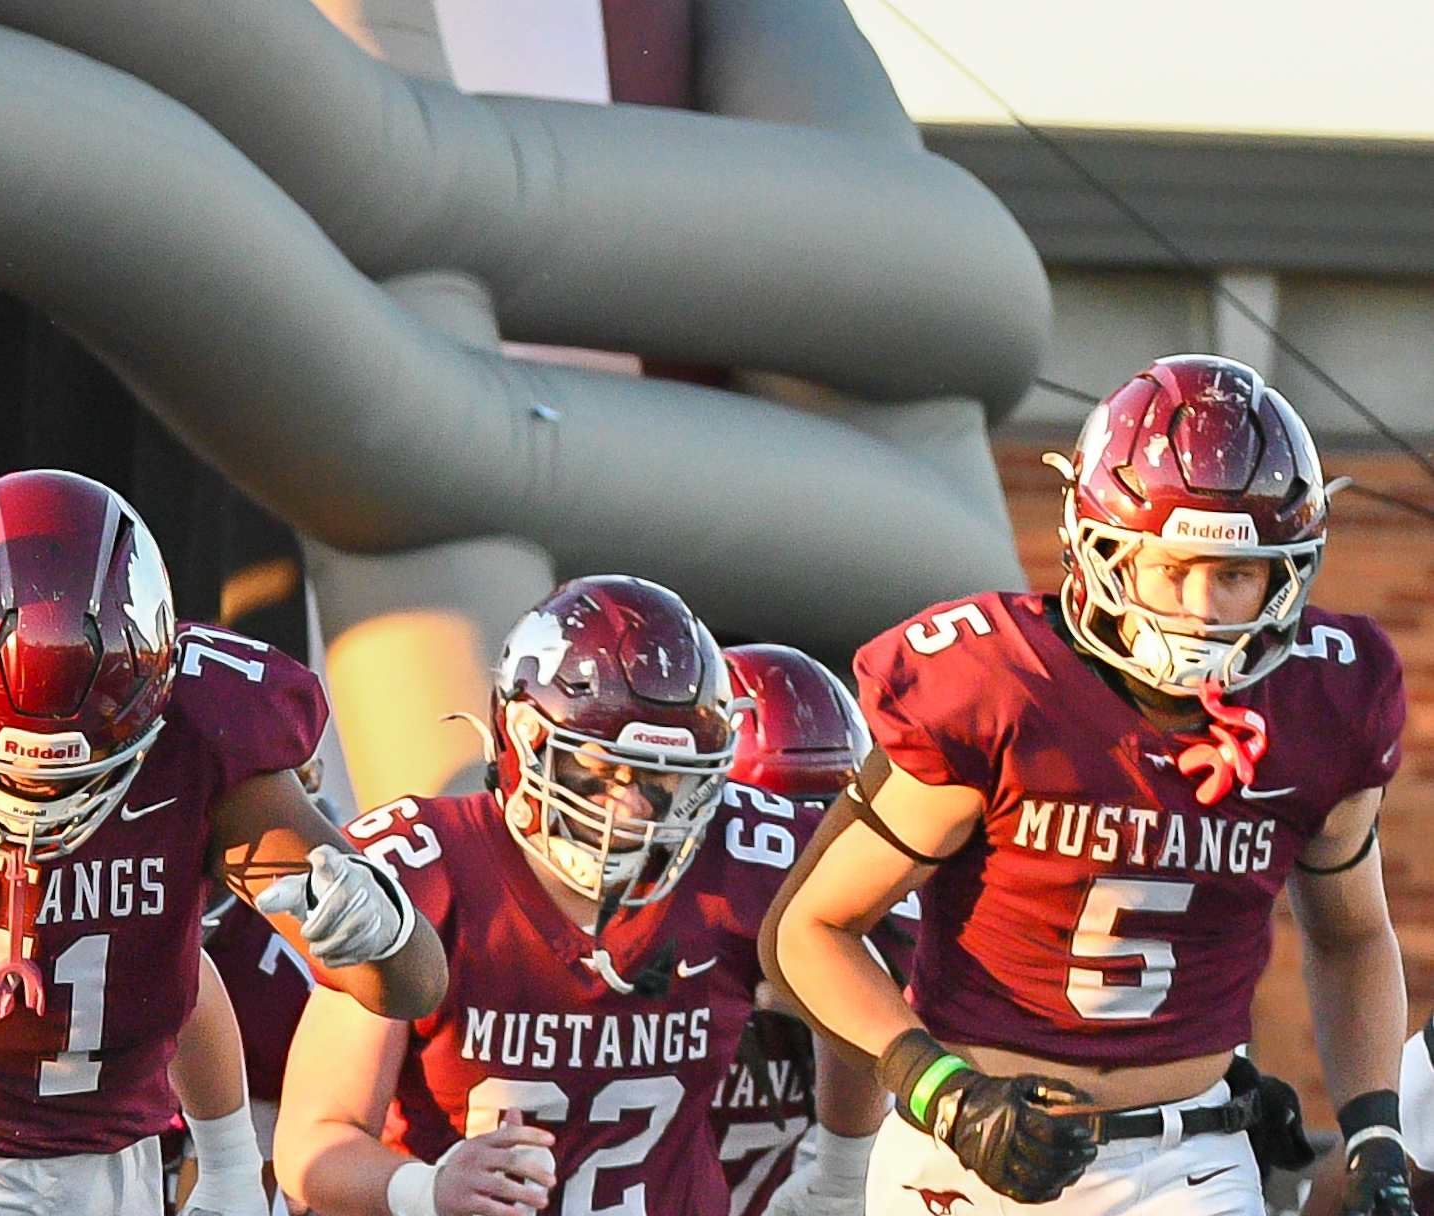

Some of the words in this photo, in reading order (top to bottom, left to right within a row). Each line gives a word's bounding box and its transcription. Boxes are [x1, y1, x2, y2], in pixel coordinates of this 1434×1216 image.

[1177, 521, 1250, 540] Riddell
[181, 625, 270, 683] 71
[904, 603, 996, 657] 5
[5, 740, 81, 760] Riddell
[347, 797, 442, 881] 62
[723, 781, 796, 870] 62
[1013, 801, 1275, 873] MUSTANGS
[1066, 878, 1195, 1021] 5
[461, 1006, 711, 1069] MUSTANGS
